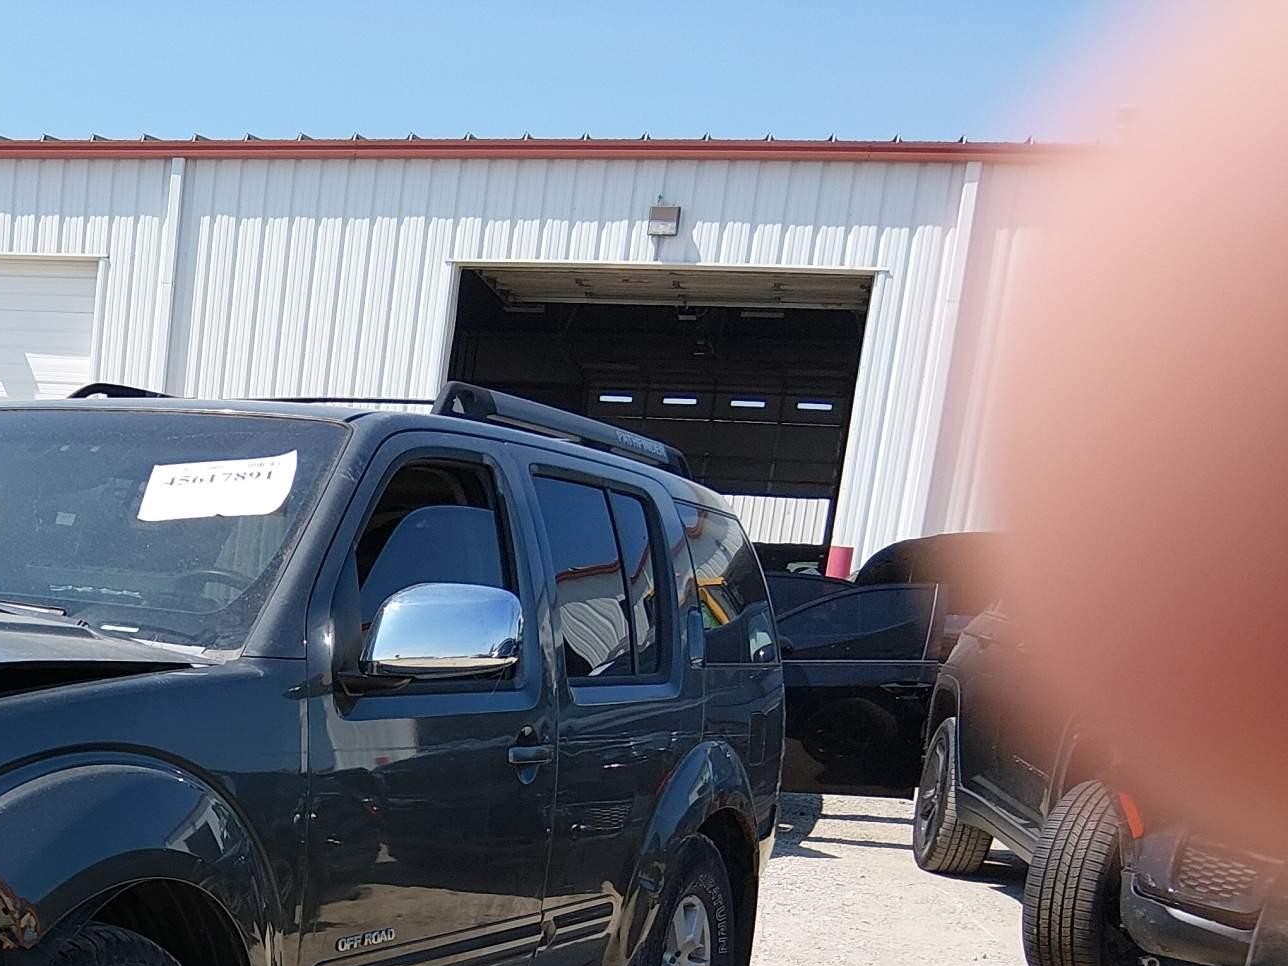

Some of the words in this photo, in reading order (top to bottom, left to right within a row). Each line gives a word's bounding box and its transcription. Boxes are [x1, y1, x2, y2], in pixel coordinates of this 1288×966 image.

[161, 470, 274, 487] 45617891
[336, 936, 361, 952] OFF
[363, 927, 396, 946] ROAD
